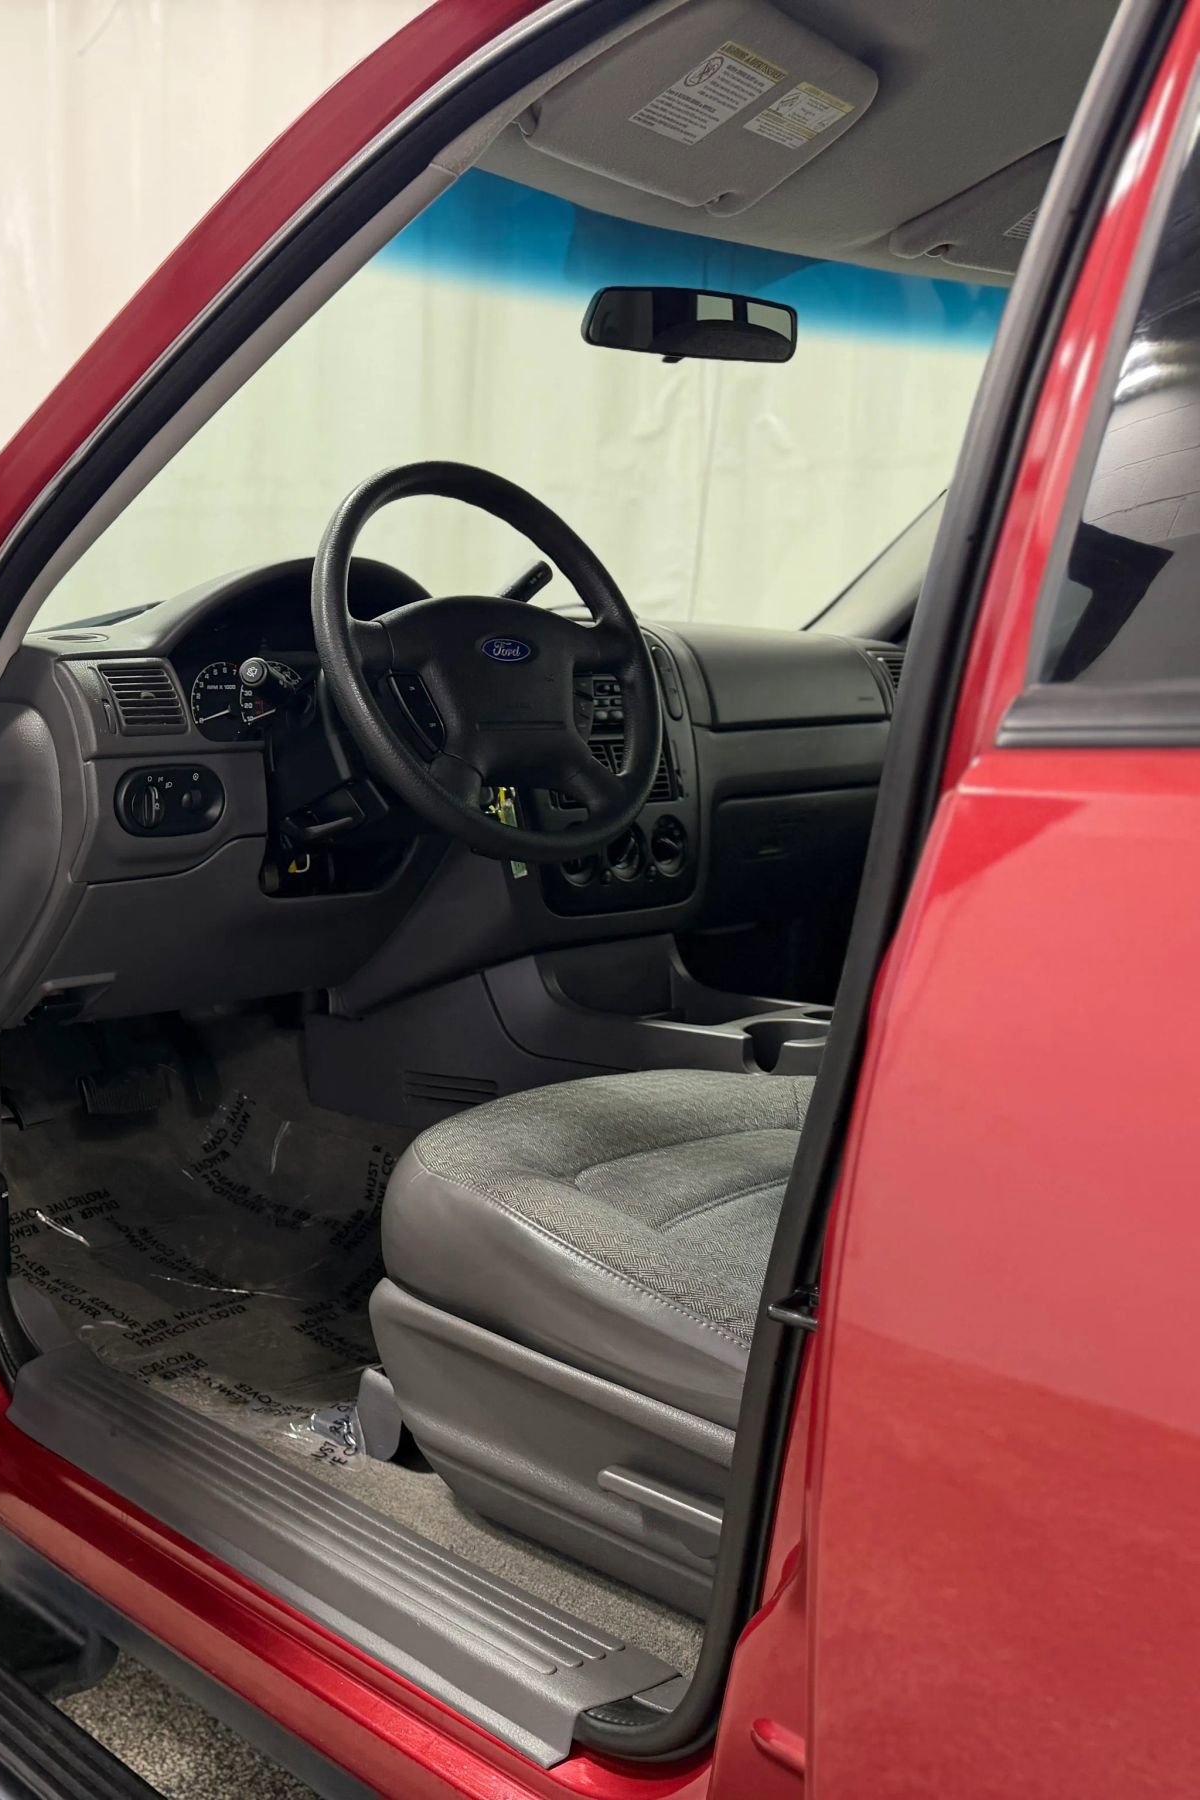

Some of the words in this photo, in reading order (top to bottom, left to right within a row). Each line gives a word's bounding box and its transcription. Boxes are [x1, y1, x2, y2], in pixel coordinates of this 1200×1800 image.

[492, 640, 521, 657] Ford
[365, 1160, 379, 1201] MUST
[61, 1293, 102, 1319] COVER
[234, 1382, 282, 1408] COVER
